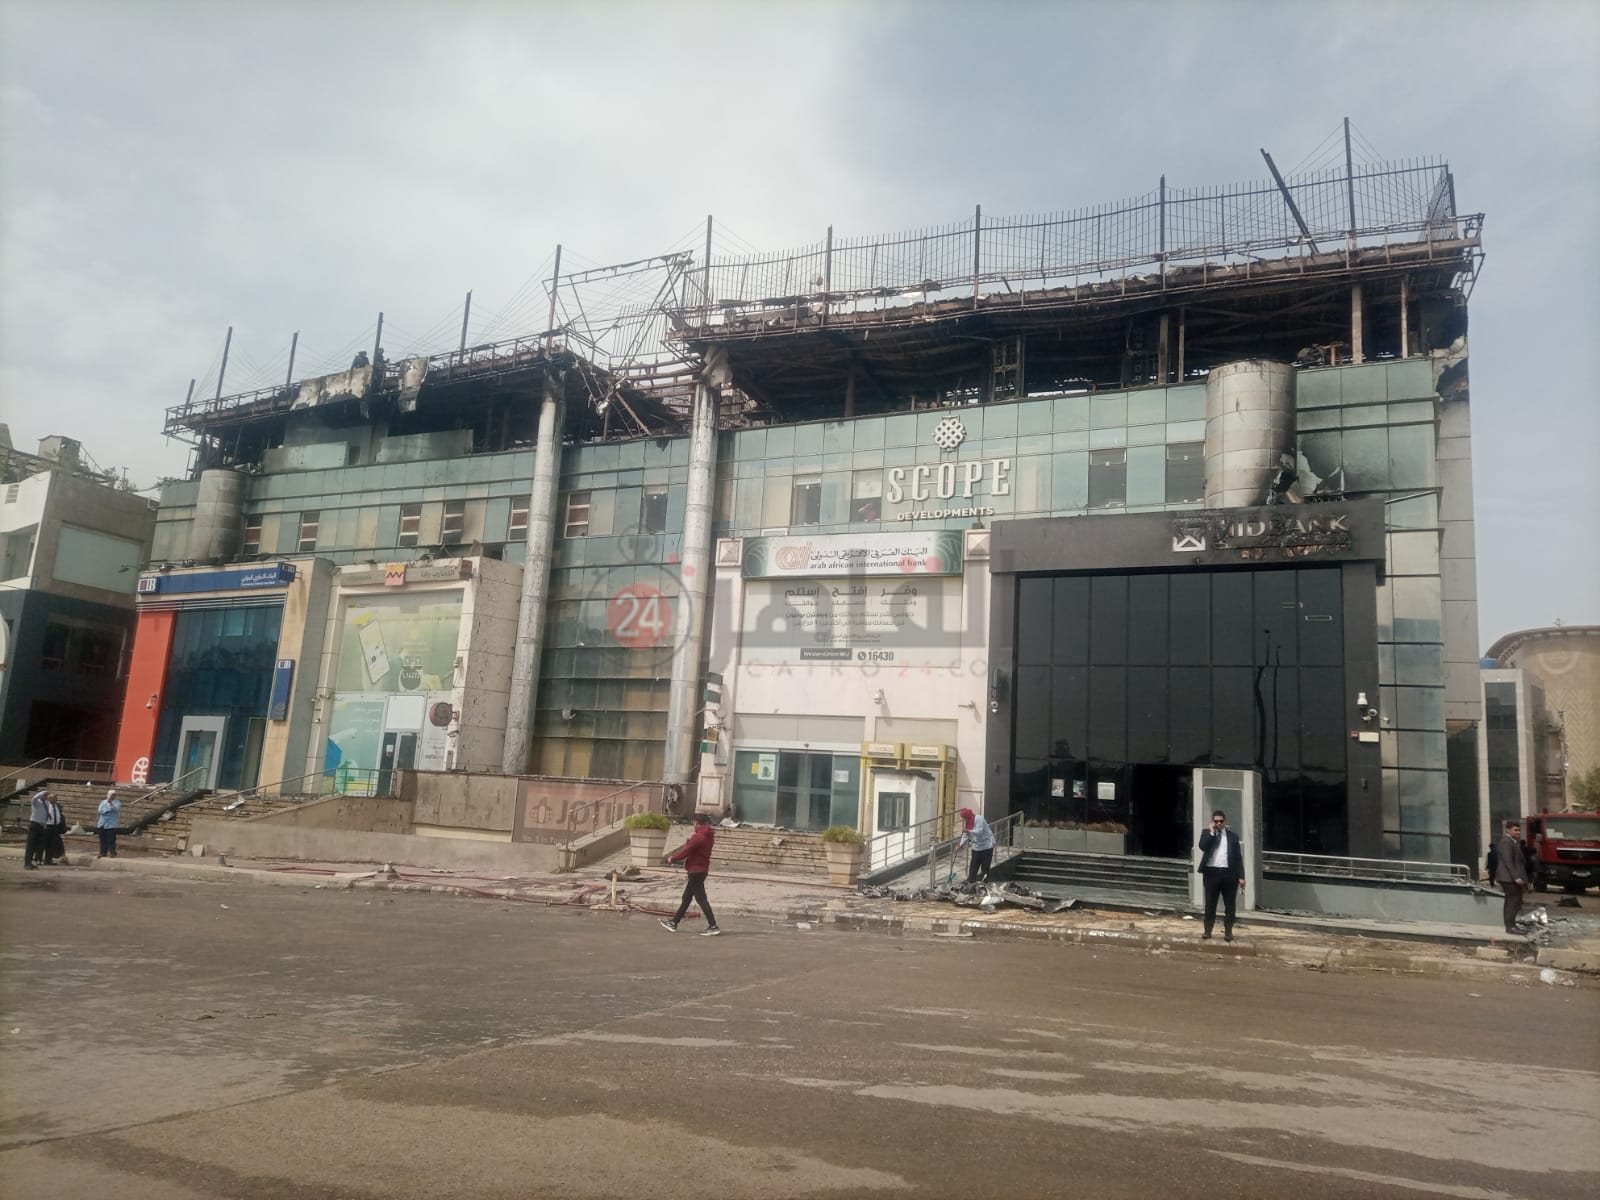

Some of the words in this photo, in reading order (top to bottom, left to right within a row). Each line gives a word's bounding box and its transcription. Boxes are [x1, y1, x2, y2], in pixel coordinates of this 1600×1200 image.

[887, 459, 1011, 503] SCOPE
[897, 506, 995, 520] DEVELOPMENTS
[809, 561, 827, 569] arab
[828, 560, 854, 569] african
[855, 559, 905, 568] international
[907, 558, 927, 567] bank
[868, 651, 894, 661] 16430
